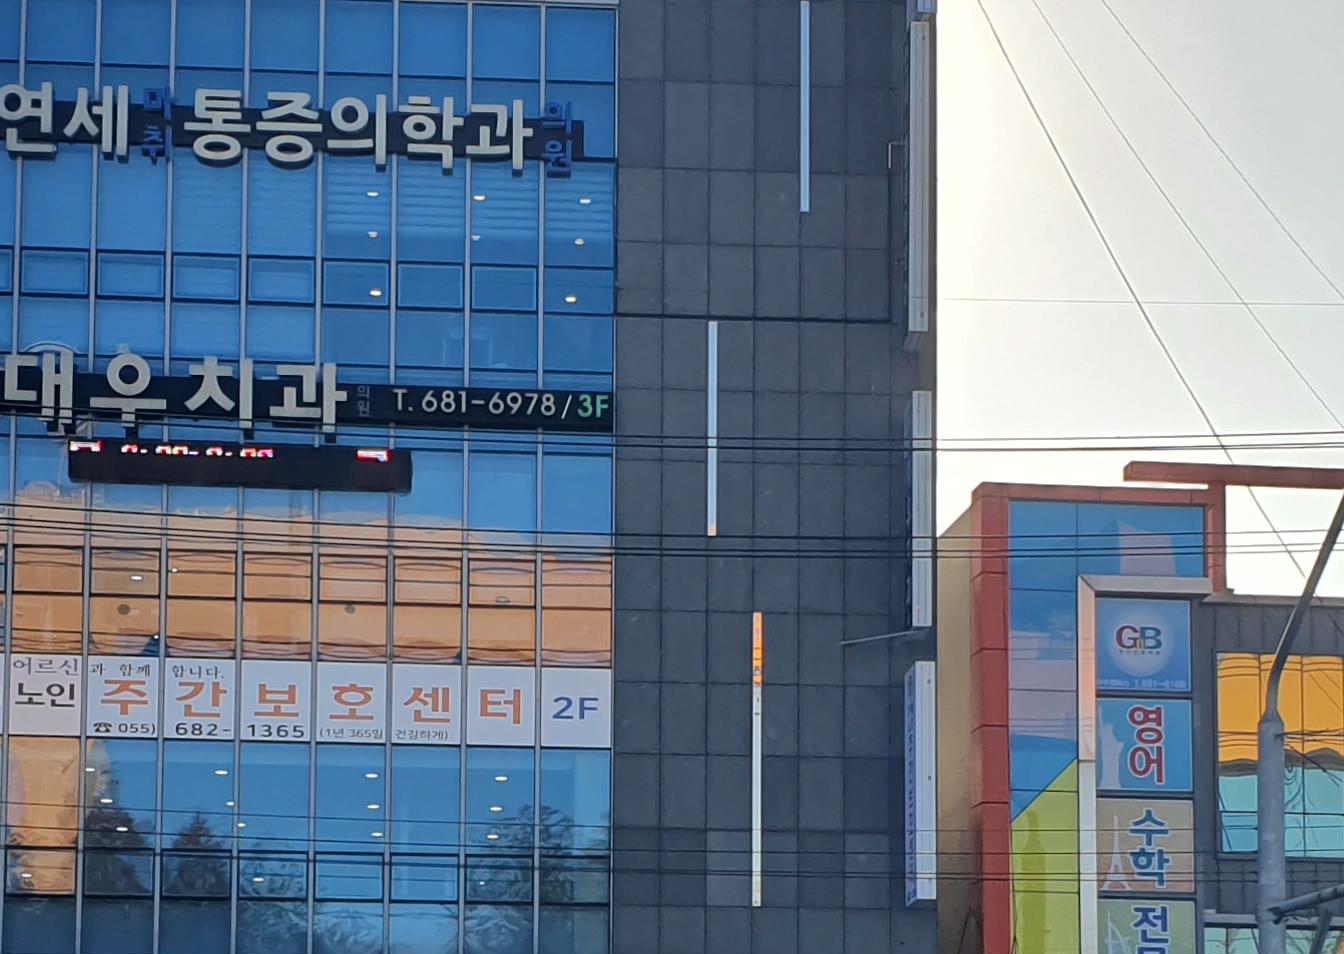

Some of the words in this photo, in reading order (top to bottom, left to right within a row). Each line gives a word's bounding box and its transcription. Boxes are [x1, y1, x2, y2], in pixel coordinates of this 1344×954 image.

[183, 88, 534, 178] 통증의학과
[543, 99, 573, 179] 의원
[4, 348, 349, 438] 대우치과
[392, 388, 414, 413] T.
[1115, 624, 1163, 651] GnB
[14, 680, 77, 708] 노인
[551, 695, 600, 721] 2F
[117, 721, 157, 736] 055)
[1127, 704, 1165, 786] 영어
[1128, 808, 1171, 888] 수학
